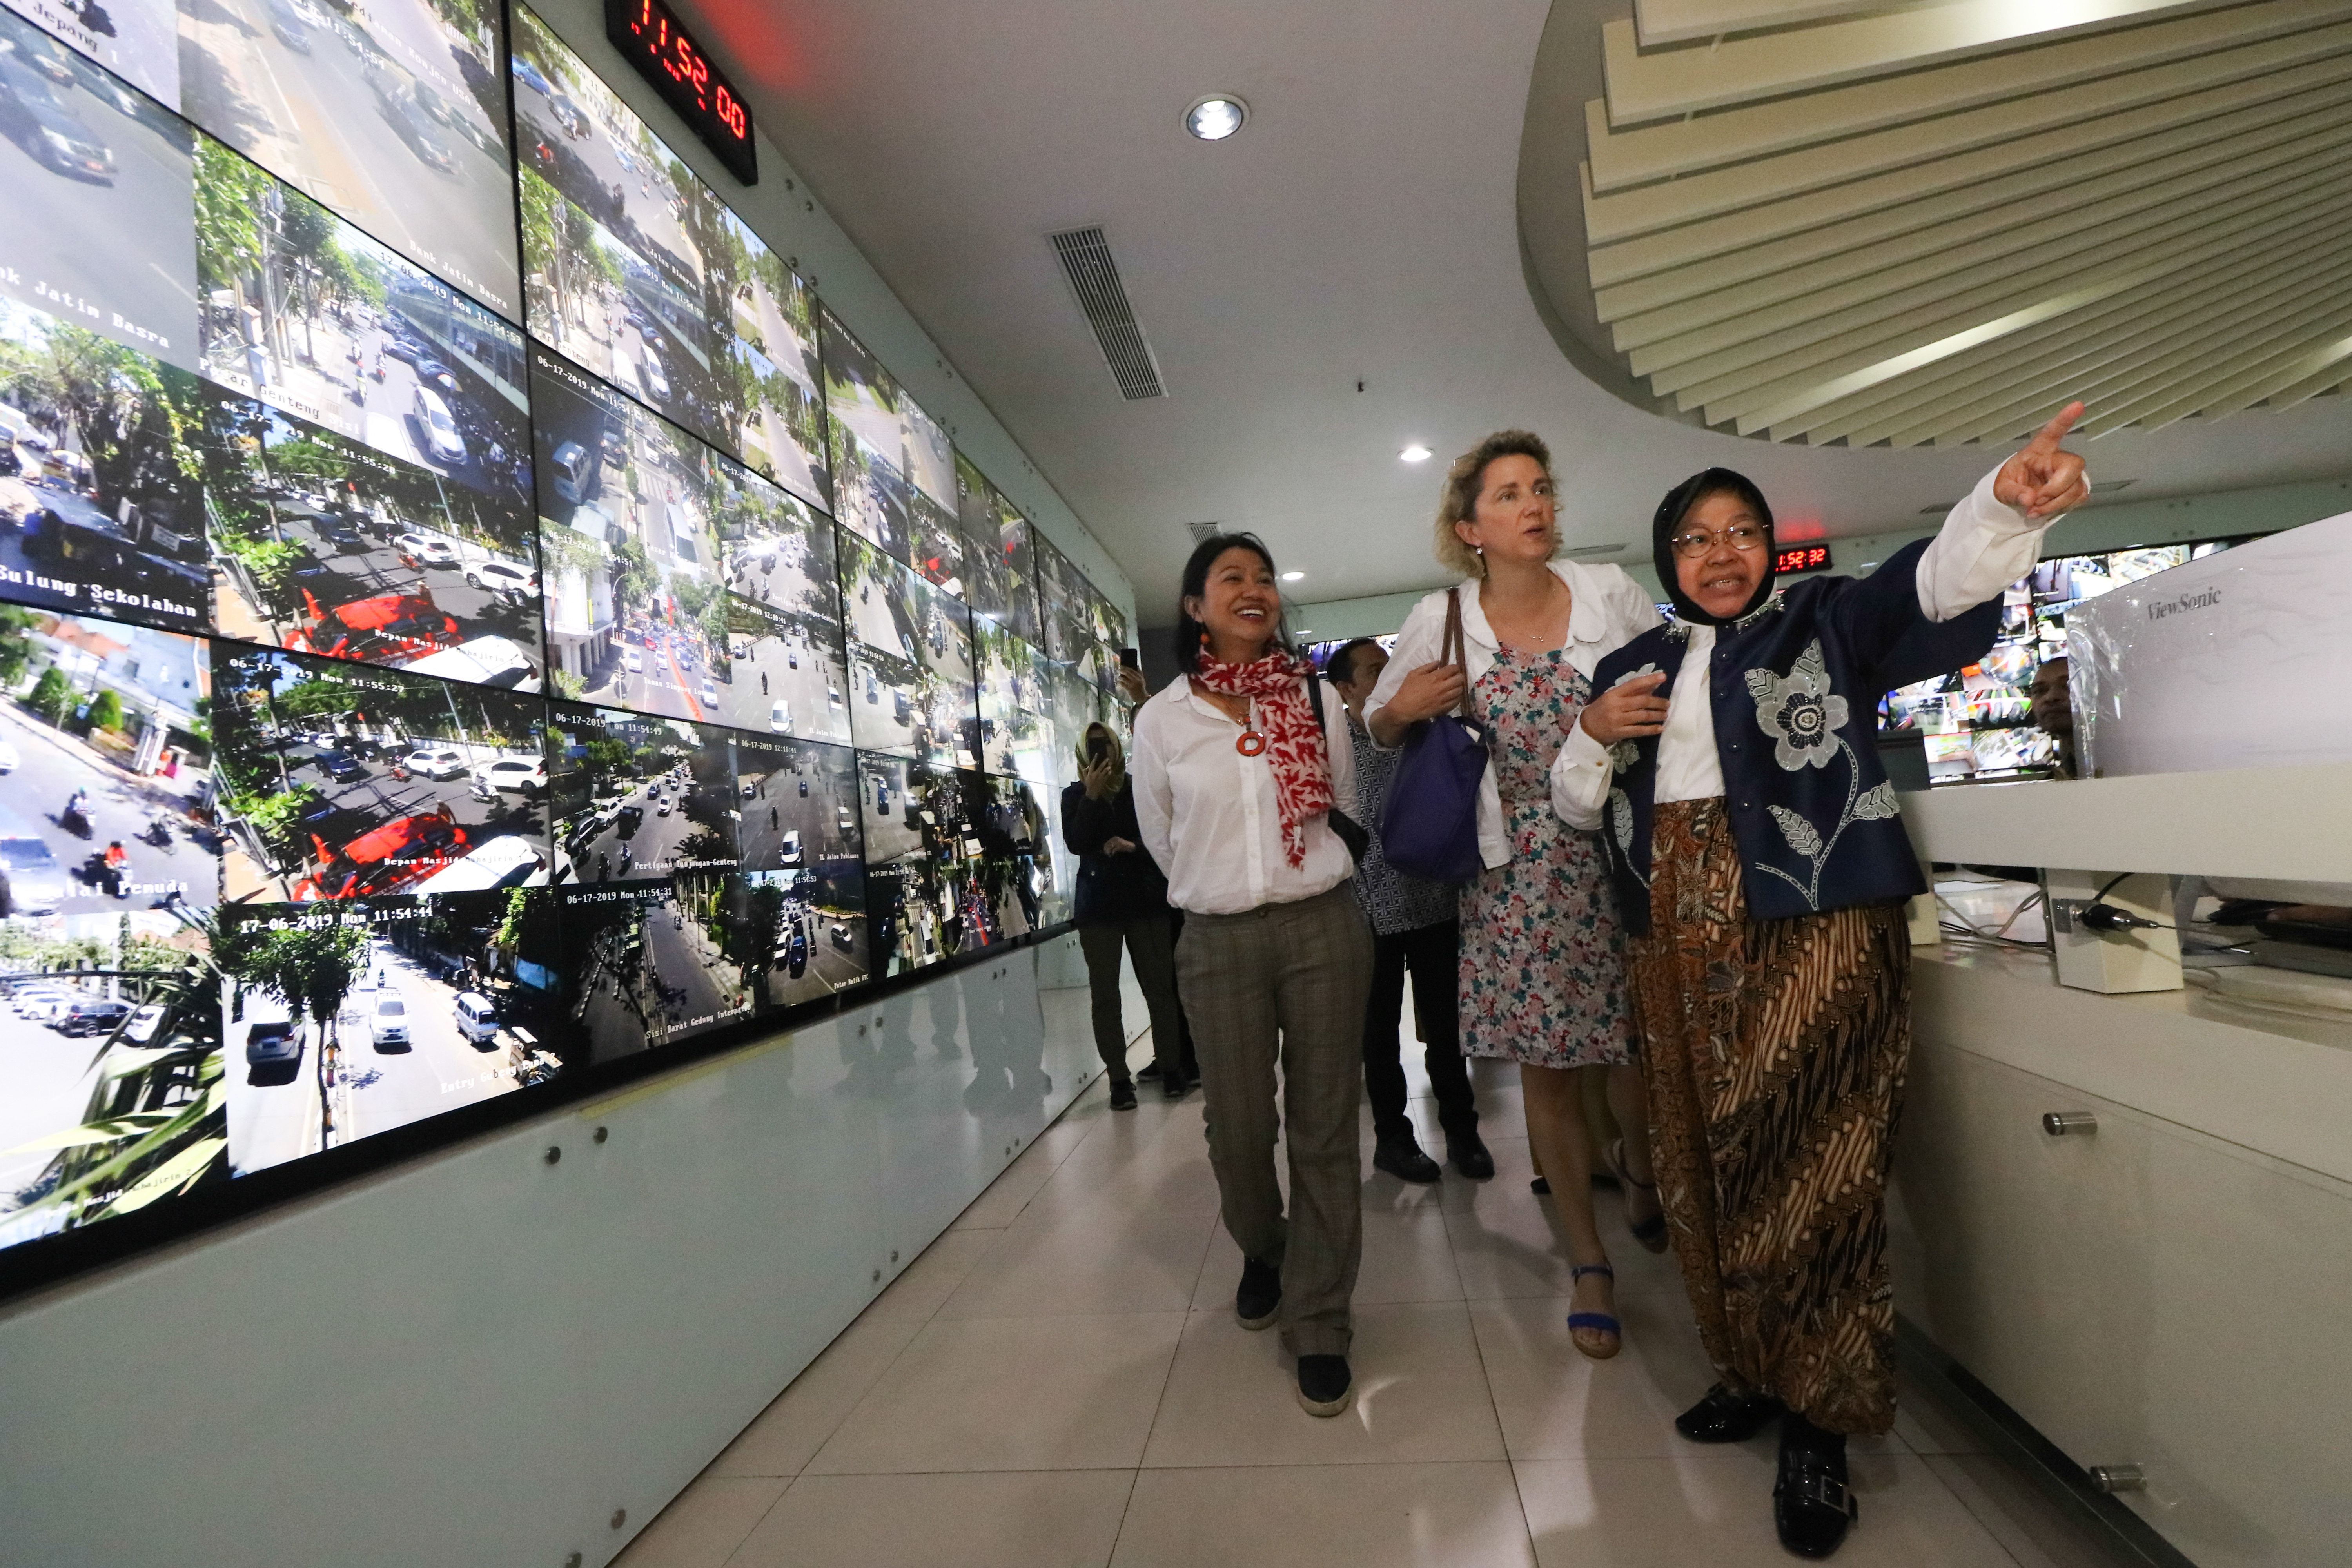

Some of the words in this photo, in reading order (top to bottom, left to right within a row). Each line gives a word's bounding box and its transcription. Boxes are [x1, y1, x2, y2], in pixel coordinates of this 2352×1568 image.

[34, 2, 98, 53] Jepang
[650, 248, 670, 269] Jalan
[409, 239, 437, 265] Bank
[442, 261, 474, 288] Jatim
[479, 283, 508, 310] Basra
[661, 279, 673, 294] Mon
[35, 280, 100, 318] Jatim
[112, 312, 170, 348] Basra
[452, 295, 471, 315] Mon
[477, 311, 522, 345] 11:54:53
[537, 355, 588, 390] 06-17-2019
[590, 385, 605, 401] Mon
[616, 375, 637, 394] Timur
[259, 383, 319, 420] Genteng
[329, 413, 359, 435] Sisi
[221, 400, 305, 439] 06-17-2019
[312, 435, 334, 451] Mon
[90, 583, 197, 617] Sekolahan
[731, 598, 762, 616] 06-17-2019
[764, 610, 787, 625] 12:10:41
[2148, 586, 2221, 621] ViewSonic
[374, 628, 408, 643] Depan
[413, 637, 450, 650] Masjid
[229, 658, 313, 679] 06-17-2019
[320, 673, 344, 684] Mon
[351, 678, 405, 693] 11:55:27
[555, 713, 606, 728] 06-17-2019
[628, 723, 662, 735] 11:54:49
[741, 739, 772, 750] 06-17-2019
[775, 744, 797, 754] 12:10:41
[384, 857, 417, 867] Depan
[422, 856, 459, 866] Masjid
[634, 861, 673, 871] Pertigaan
[118, 879, 189, 897] Pemuda
[566, 891, 617, 904] 06-17-2019
[620, 891, 635, 900] Mon
[638, 887, 672, 898] 11:54:31
[240, 913, 333, 934] 17-06-2019
[341, 912, 367, 925] Mon
[374, 906, 434, 922] 11:54:44
[646, 1027, 663, 1040] Sisi
[667, 1021, 688, 1033] Barat
[690, 1014, 714, 1027] Gedung
[440, 1077, 475, 1094] Entry
[480, 1065, 517, 1083] Gubeng
